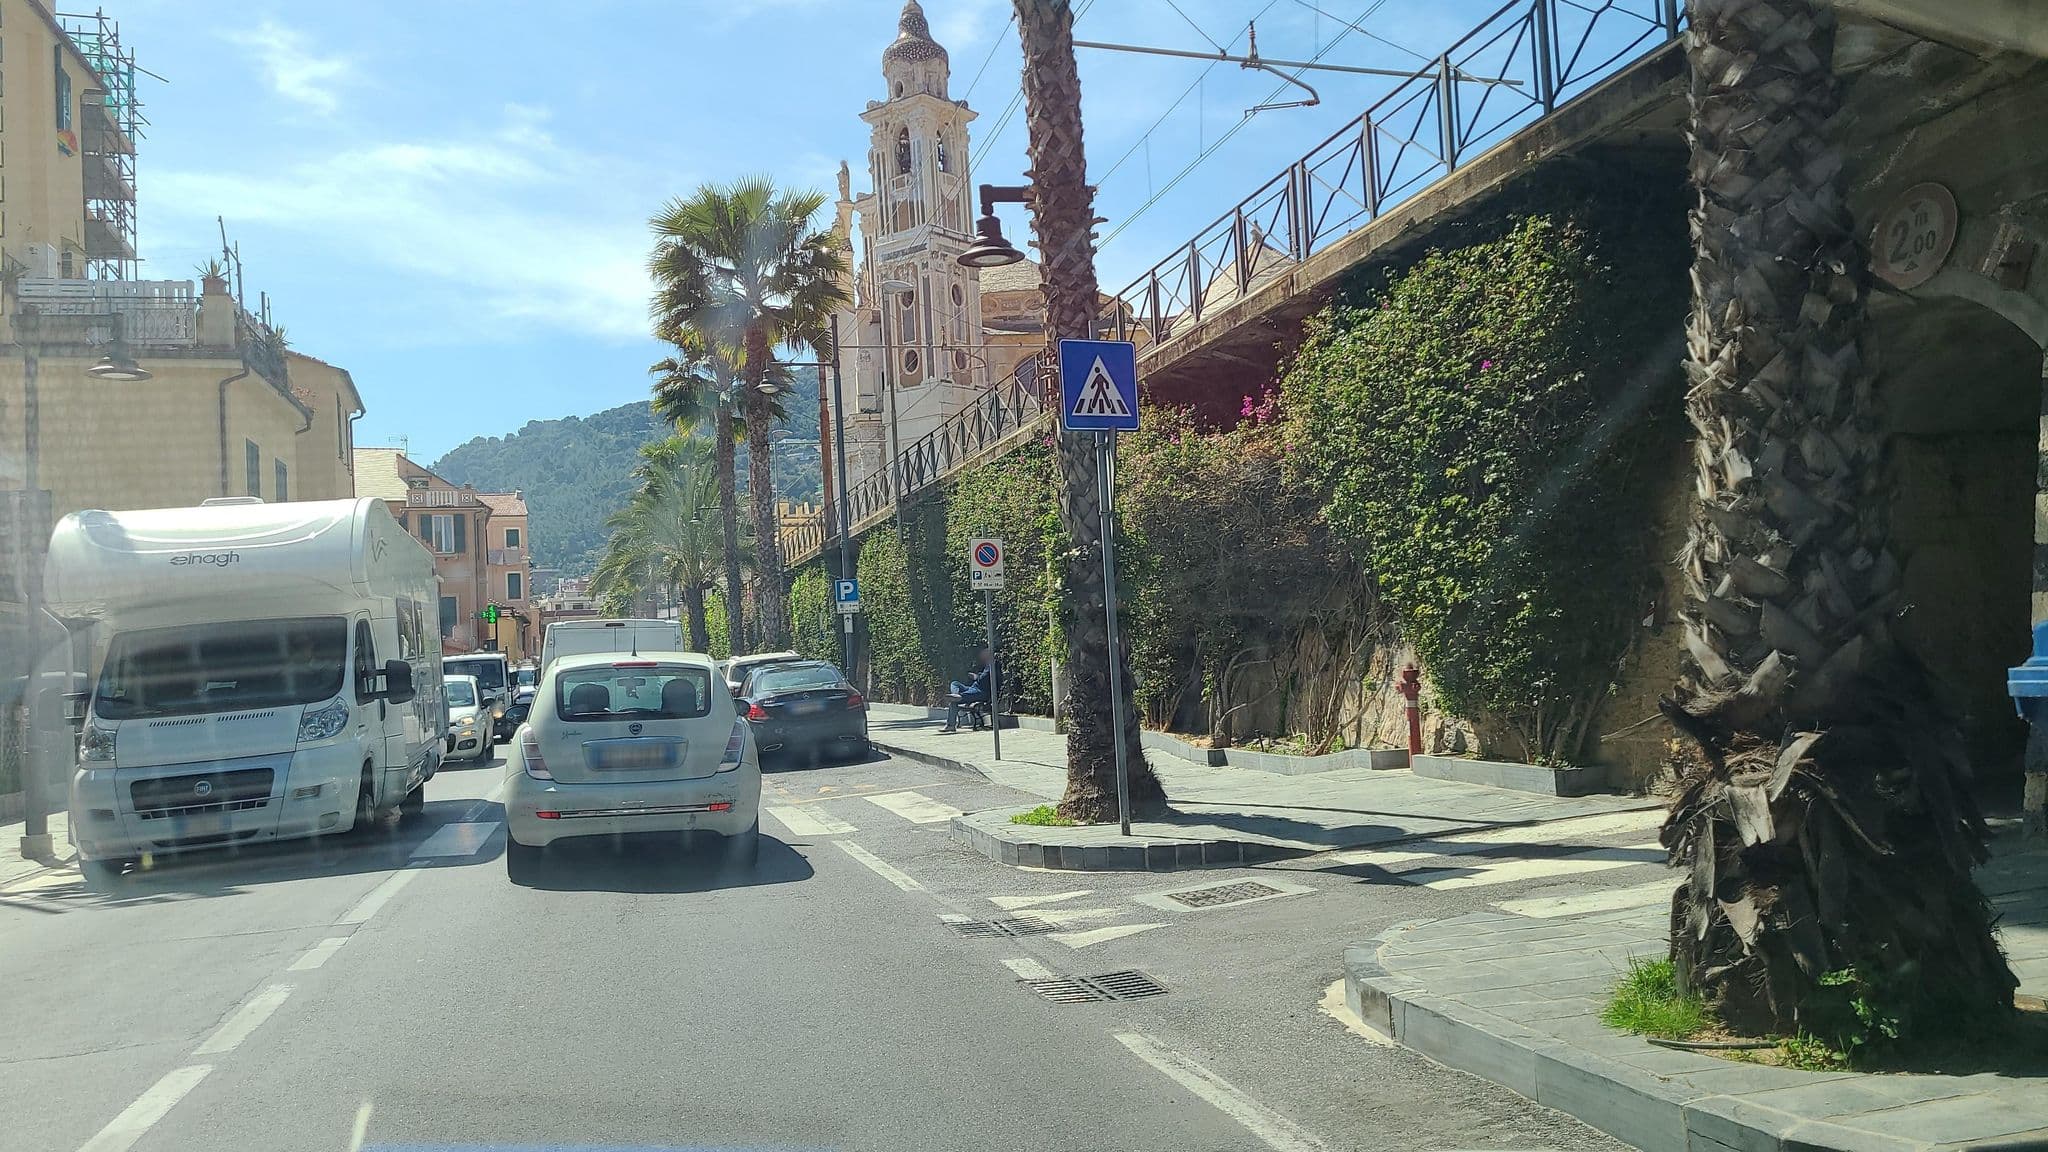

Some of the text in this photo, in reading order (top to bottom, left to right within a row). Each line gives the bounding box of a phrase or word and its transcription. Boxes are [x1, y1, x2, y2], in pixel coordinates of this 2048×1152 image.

[169, 551, 240, 567] elnagh
[974, 571, 981, 579] P
[839, 581, 854, 600] P
